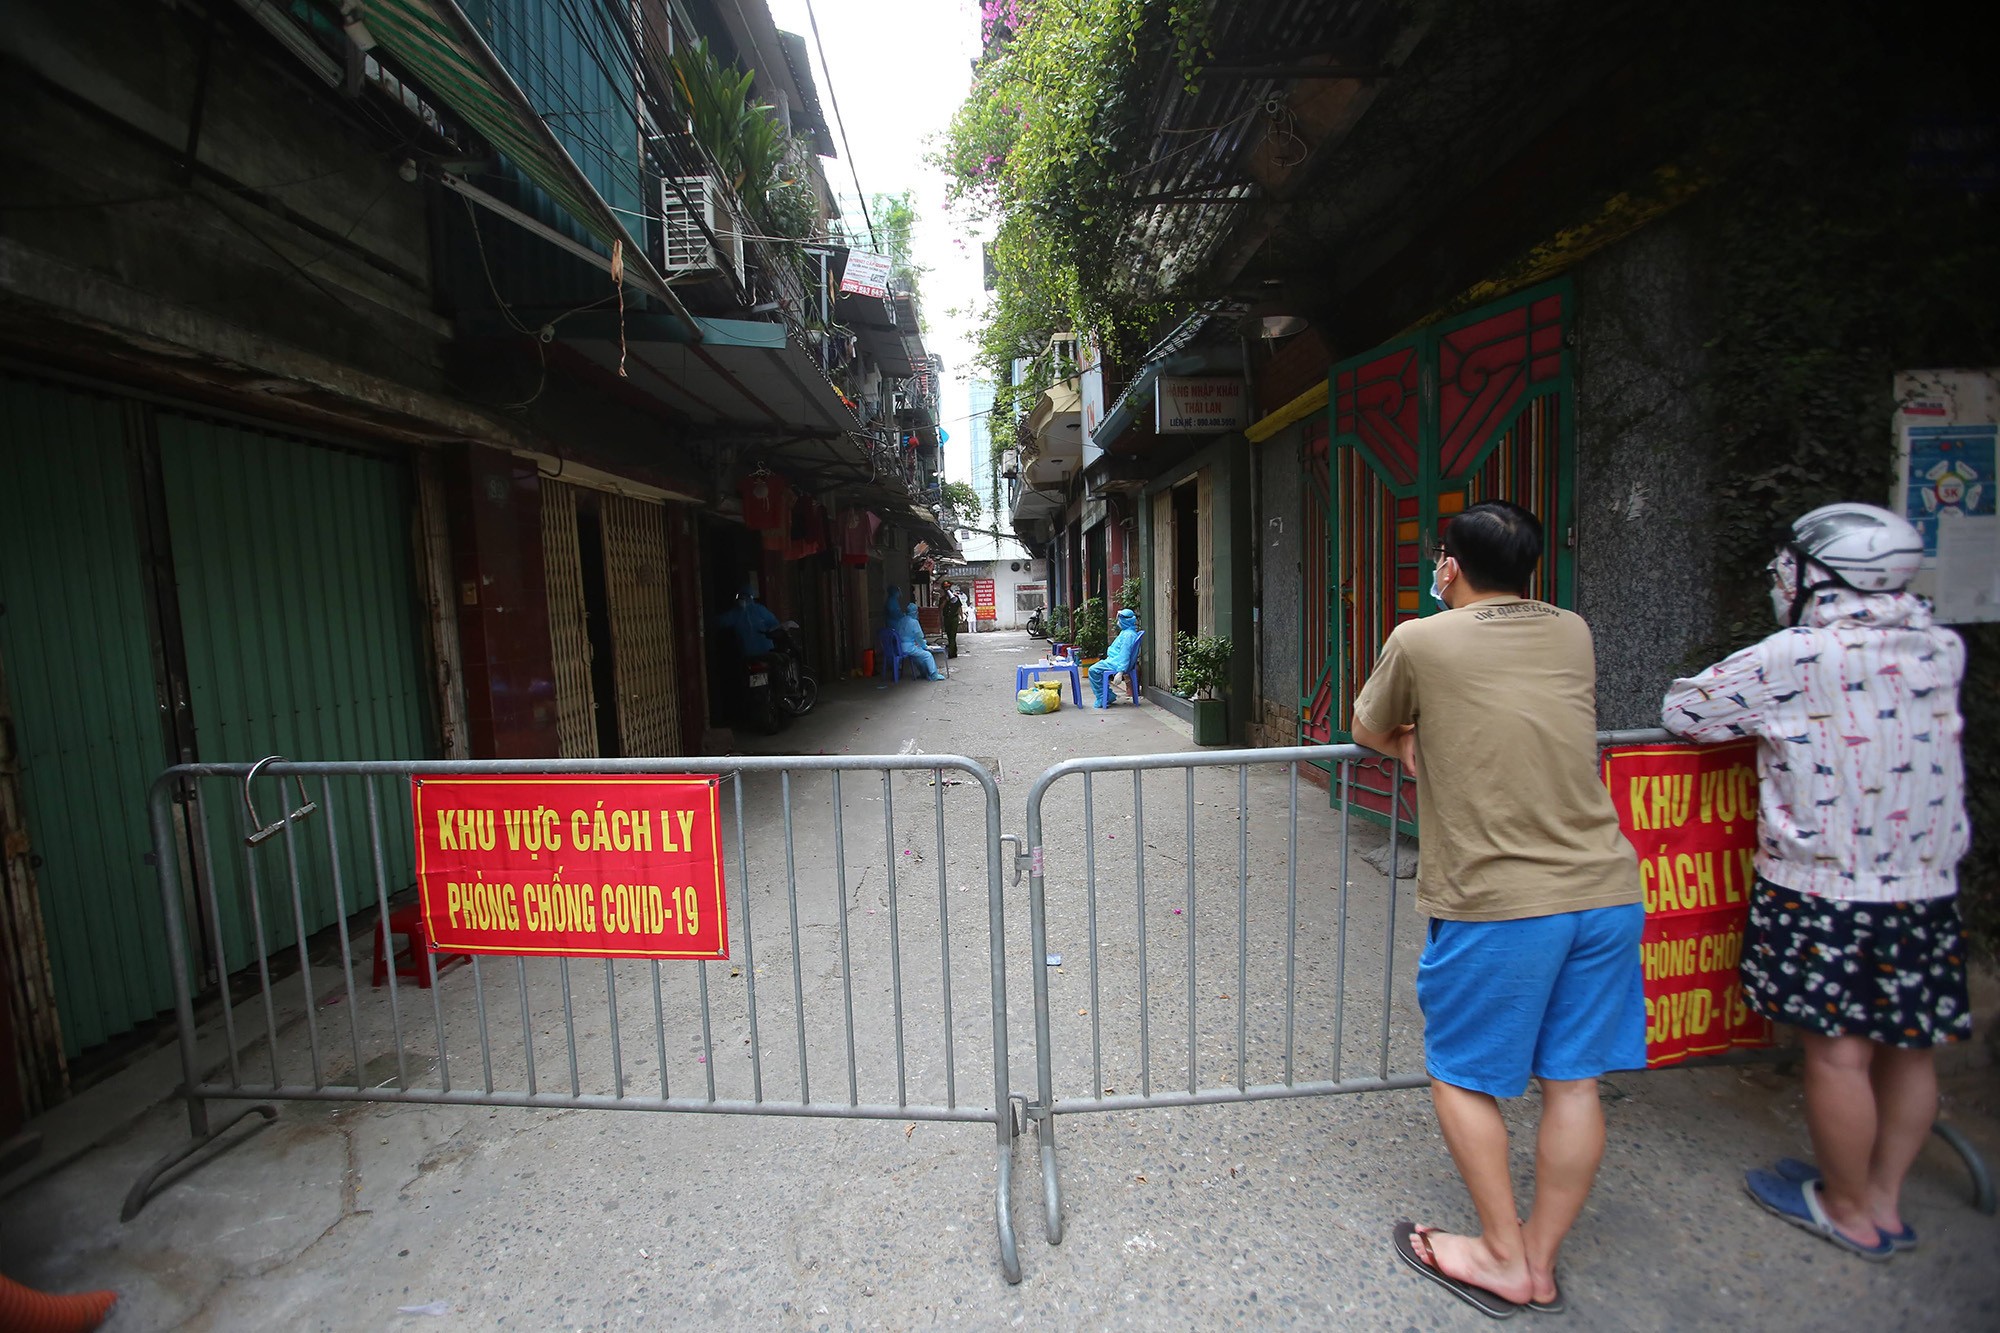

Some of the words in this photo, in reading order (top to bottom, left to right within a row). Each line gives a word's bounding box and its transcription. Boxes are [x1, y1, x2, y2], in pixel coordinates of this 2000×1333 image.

[1205, 402, 1221, 414] LAN
[1497, 603, 1560, 618] question
[437, 809, 496, 851] KHU
[503, 805, 562, 861] VỰC
[571, 801, 652, 852] CÁCH
[661, 810, 695, 853] LY
[1630, 774, 1693, 831] KHU
[1700, 762, 1757, 835] VỰC
[447, 870, 520, 931] PHÒNG
[523, 866, 597, 934] CHỐNG
[601, 884, 700, 936] COVID-19
[1639, 844, 1716, 914] CÁCH
